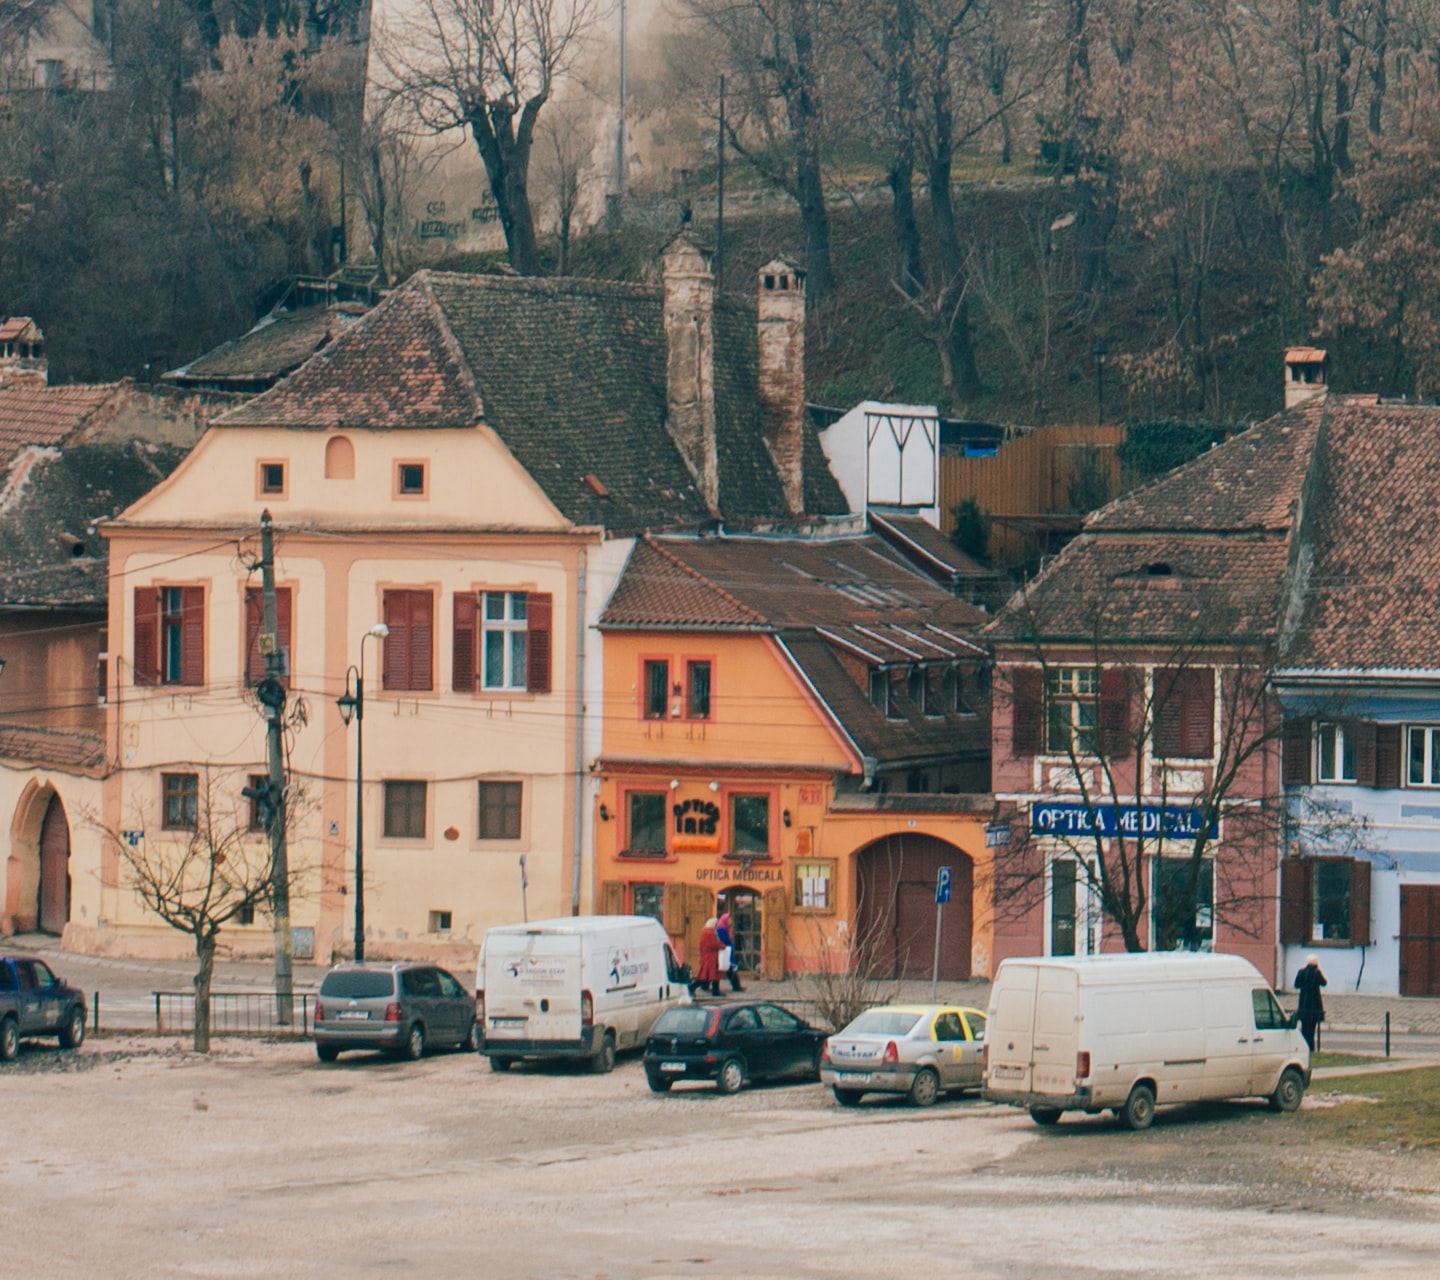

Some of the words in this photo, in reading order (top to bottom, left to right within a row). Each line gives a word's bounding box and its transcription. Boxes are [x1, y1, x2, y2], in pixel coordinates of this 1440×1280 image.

[673, 799, 720, 822] OPTICA
[1038, 806, 1106, 832] OPTICA
[1114, 810, 1211, 834] MEDICAL
[675, 818, 717, 834] IRIS
[696, 868, 730, 881] OPTICA
